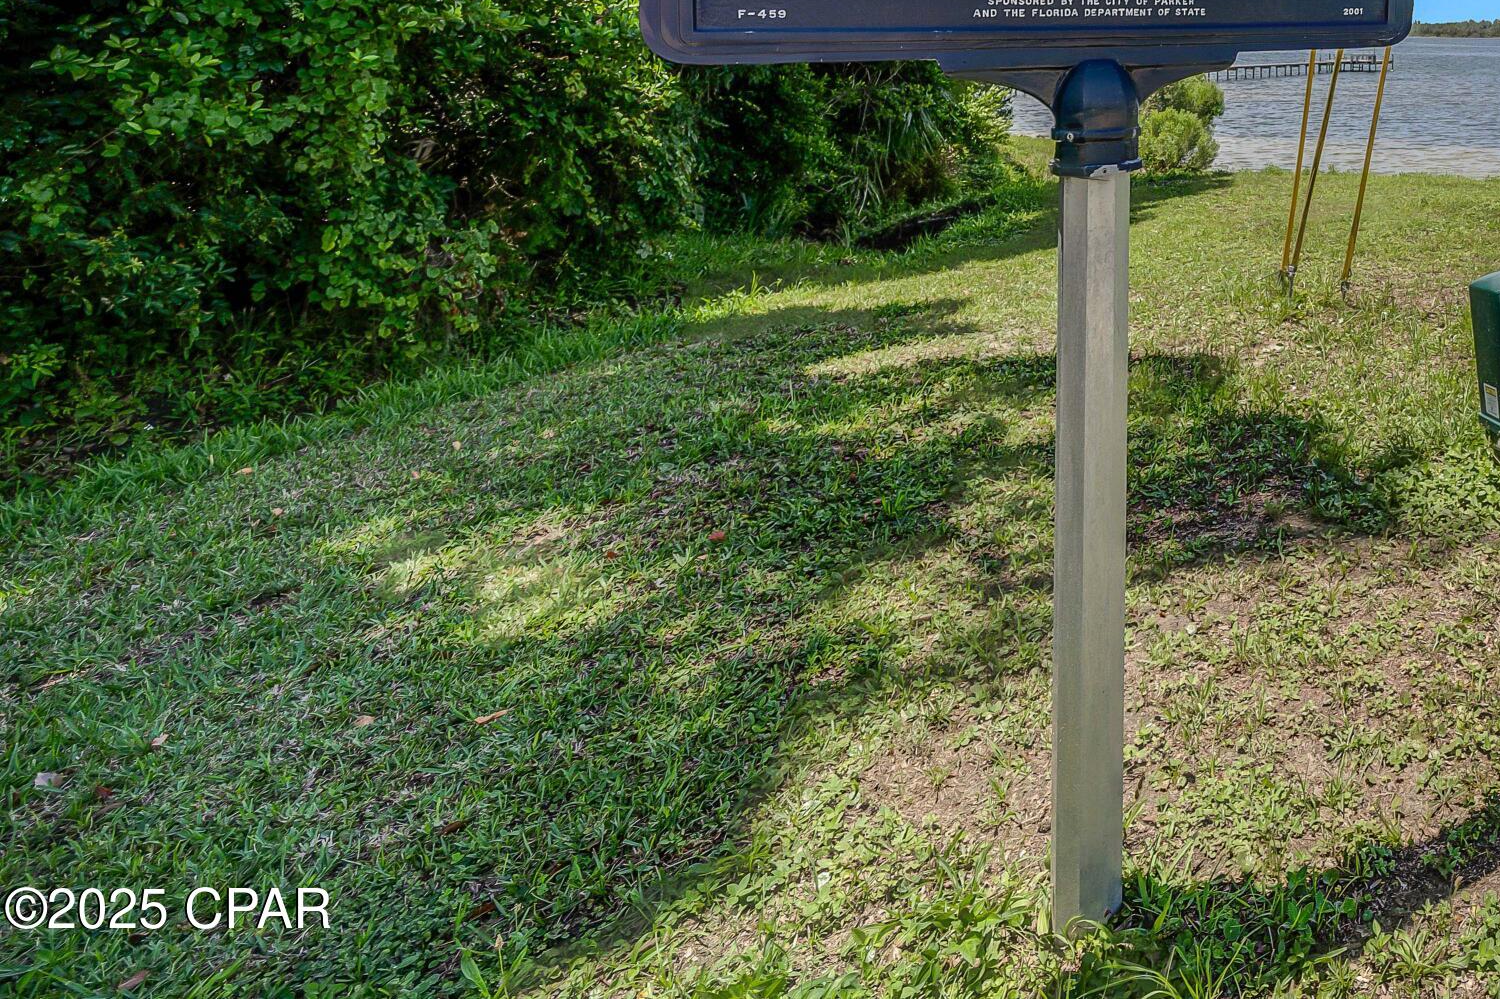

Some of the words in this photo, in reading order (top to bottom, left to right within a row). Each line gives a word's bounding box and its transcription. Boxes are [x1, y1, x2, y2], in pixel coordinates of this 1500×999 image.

[737, 8, 787, 19] F-459
[972, 8, 998, 18] AND
[1003, 8, 1026, 18] THE
[1031, 7, 1079, 17] FLORIDA
[1084, 7, 1153, 17] DEPARTMENT
[1157, 7, 1171, 16] OF
[1174, 7, 1206, 16] STATE
[1342, 7, 1364, 16] 2001
